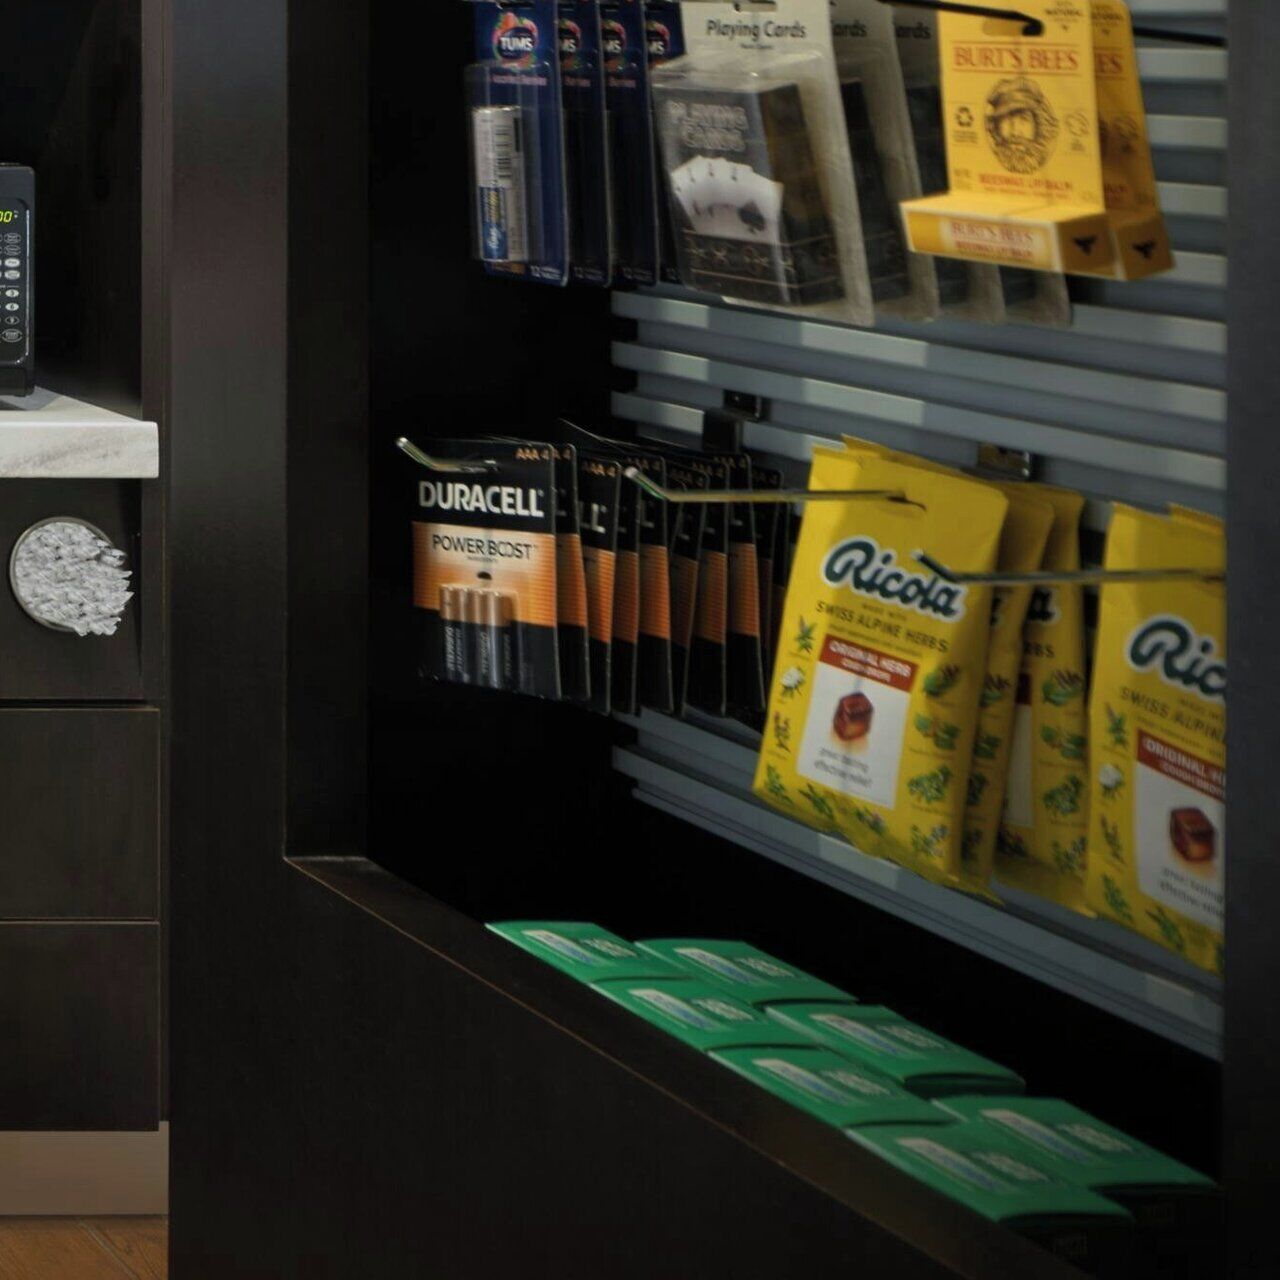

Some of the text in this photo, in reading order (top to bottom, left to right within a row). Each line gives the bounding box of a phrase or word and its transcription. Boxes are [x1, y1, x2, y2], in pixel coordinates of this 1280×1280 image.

[500, 36, 533, 52] TUMS
[706, 20, 806, 41] Playing Cards
[952, 46, 1080, 72] BURT'S BEES
[514, 448, 541, 460] AAA
[418, 480, 545, 518] DURACELL
[432, 533, 533, 561] POWER BOOST
[824, 538, 962, 618] Ricola
[852, 610, 900, 638] ALPINE
[905, 626, 949, 653] HERBS
